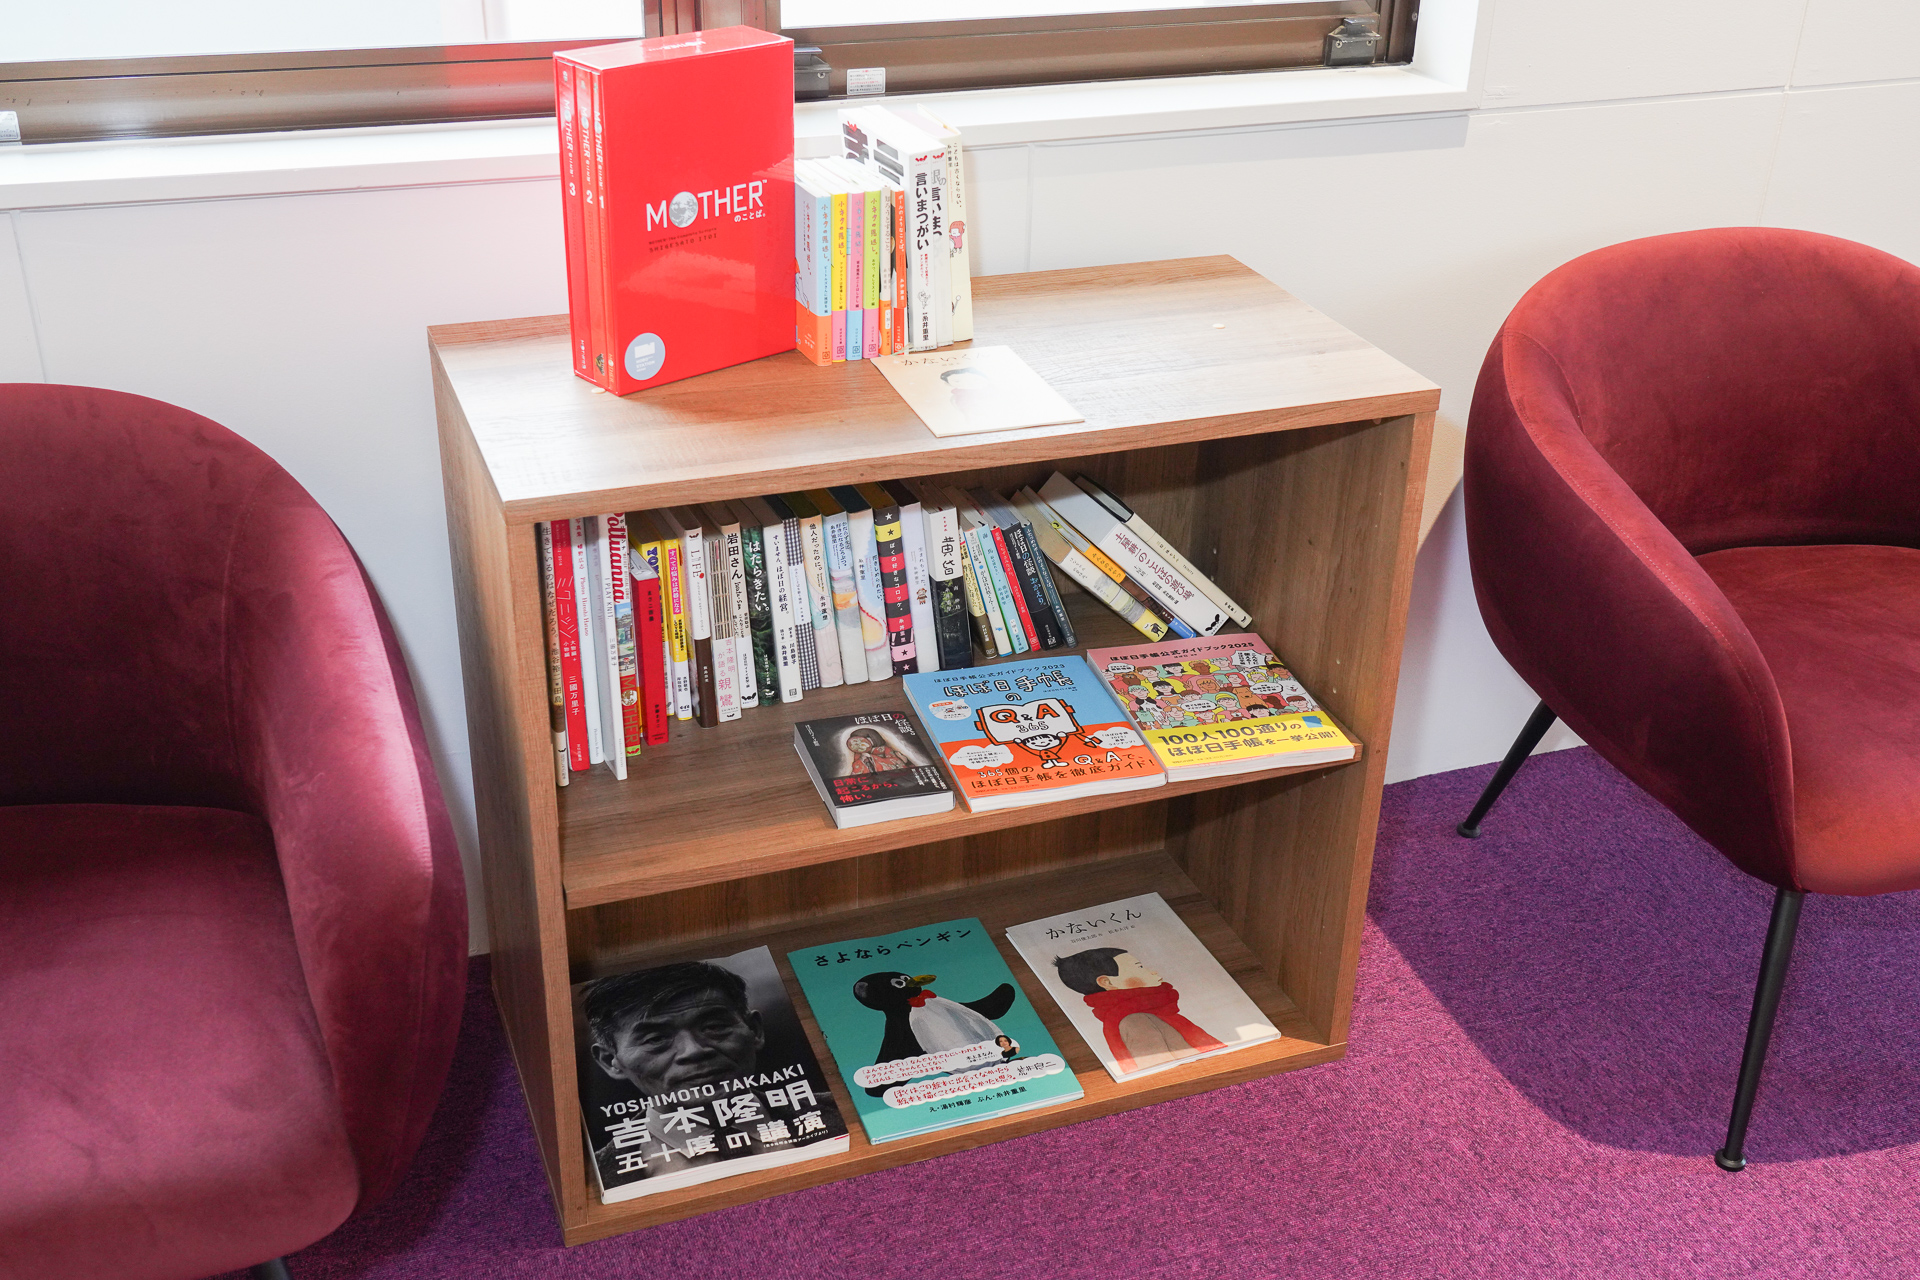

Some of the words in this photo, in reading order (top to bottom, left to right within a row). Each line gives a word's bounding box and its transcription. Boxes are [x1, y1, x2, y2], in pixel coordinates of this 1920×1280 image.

[569, 182, 576, 196] 3
[586, 189, 593, 204] 2
[598, 195, 605, 209] 1
[646, 180, 764, 231] MOTHER
[734, 209, 766, 222] のことば。
[915, 171, 930, 250] 言いまつがい
[649, 237, 695, 253] SHIGESATO
[698, 233, 718, 243] ITOI
[607, 512, 625, 604] ollyanna
[691, 549, 702, 578] LIFE
[727, 532, 742, 580] 岩田さん
[1115, 532, 1195, 600] 土屋耕一のことばの遊び場。
[749, 540, 769, 612] はたらきたい。
[773, 534, 789, 614] すいません、ほぼ日の経営。
[809, 523, 823, 571] 他人だったのに。
[820, 595, 828, 621] 糸井重里
[889, 543, 903, 611] ぼくの好きなコロッケ。
[1109, 642, 1255, 662] ほぼ日手帳公式ガイドブック2025
[933, 663, 1066, 684] ほぼ日手帳公式ガイドブック2023
[943, 669, 1074, 698] ほぼ日手帳
[569, 675, 579, 716] 三國万里子
[621, 675, 639, 744] MOTHER
[1005, 692, 1023, 702] の
[854, 712, 905, 725] ほぼ日の
[989, 703, 1061, 724] Q&A
[1015, 721, 1050, 734] 365
[1158, 721, 1302, 746] 100人100通りの
[833, 776, 869, 787] 日常に
[977, 765, 1034, 779] 365個の
[835, 781, 899, 795] 起こるから、
[839, 793, 873, 804] 怖い。
[1045, 909, 1142, 940] かないくん
[814, 929, 971, 967] さよならペンギン
[600, 1083, 715, 1118] YOSHIMOTO
[719, 1063, 806, 1092] TAKAAKI
[604, 1079, 818, 1150] 吉本隆明
[615, 1110, 827, 1175] 五十度の講演
